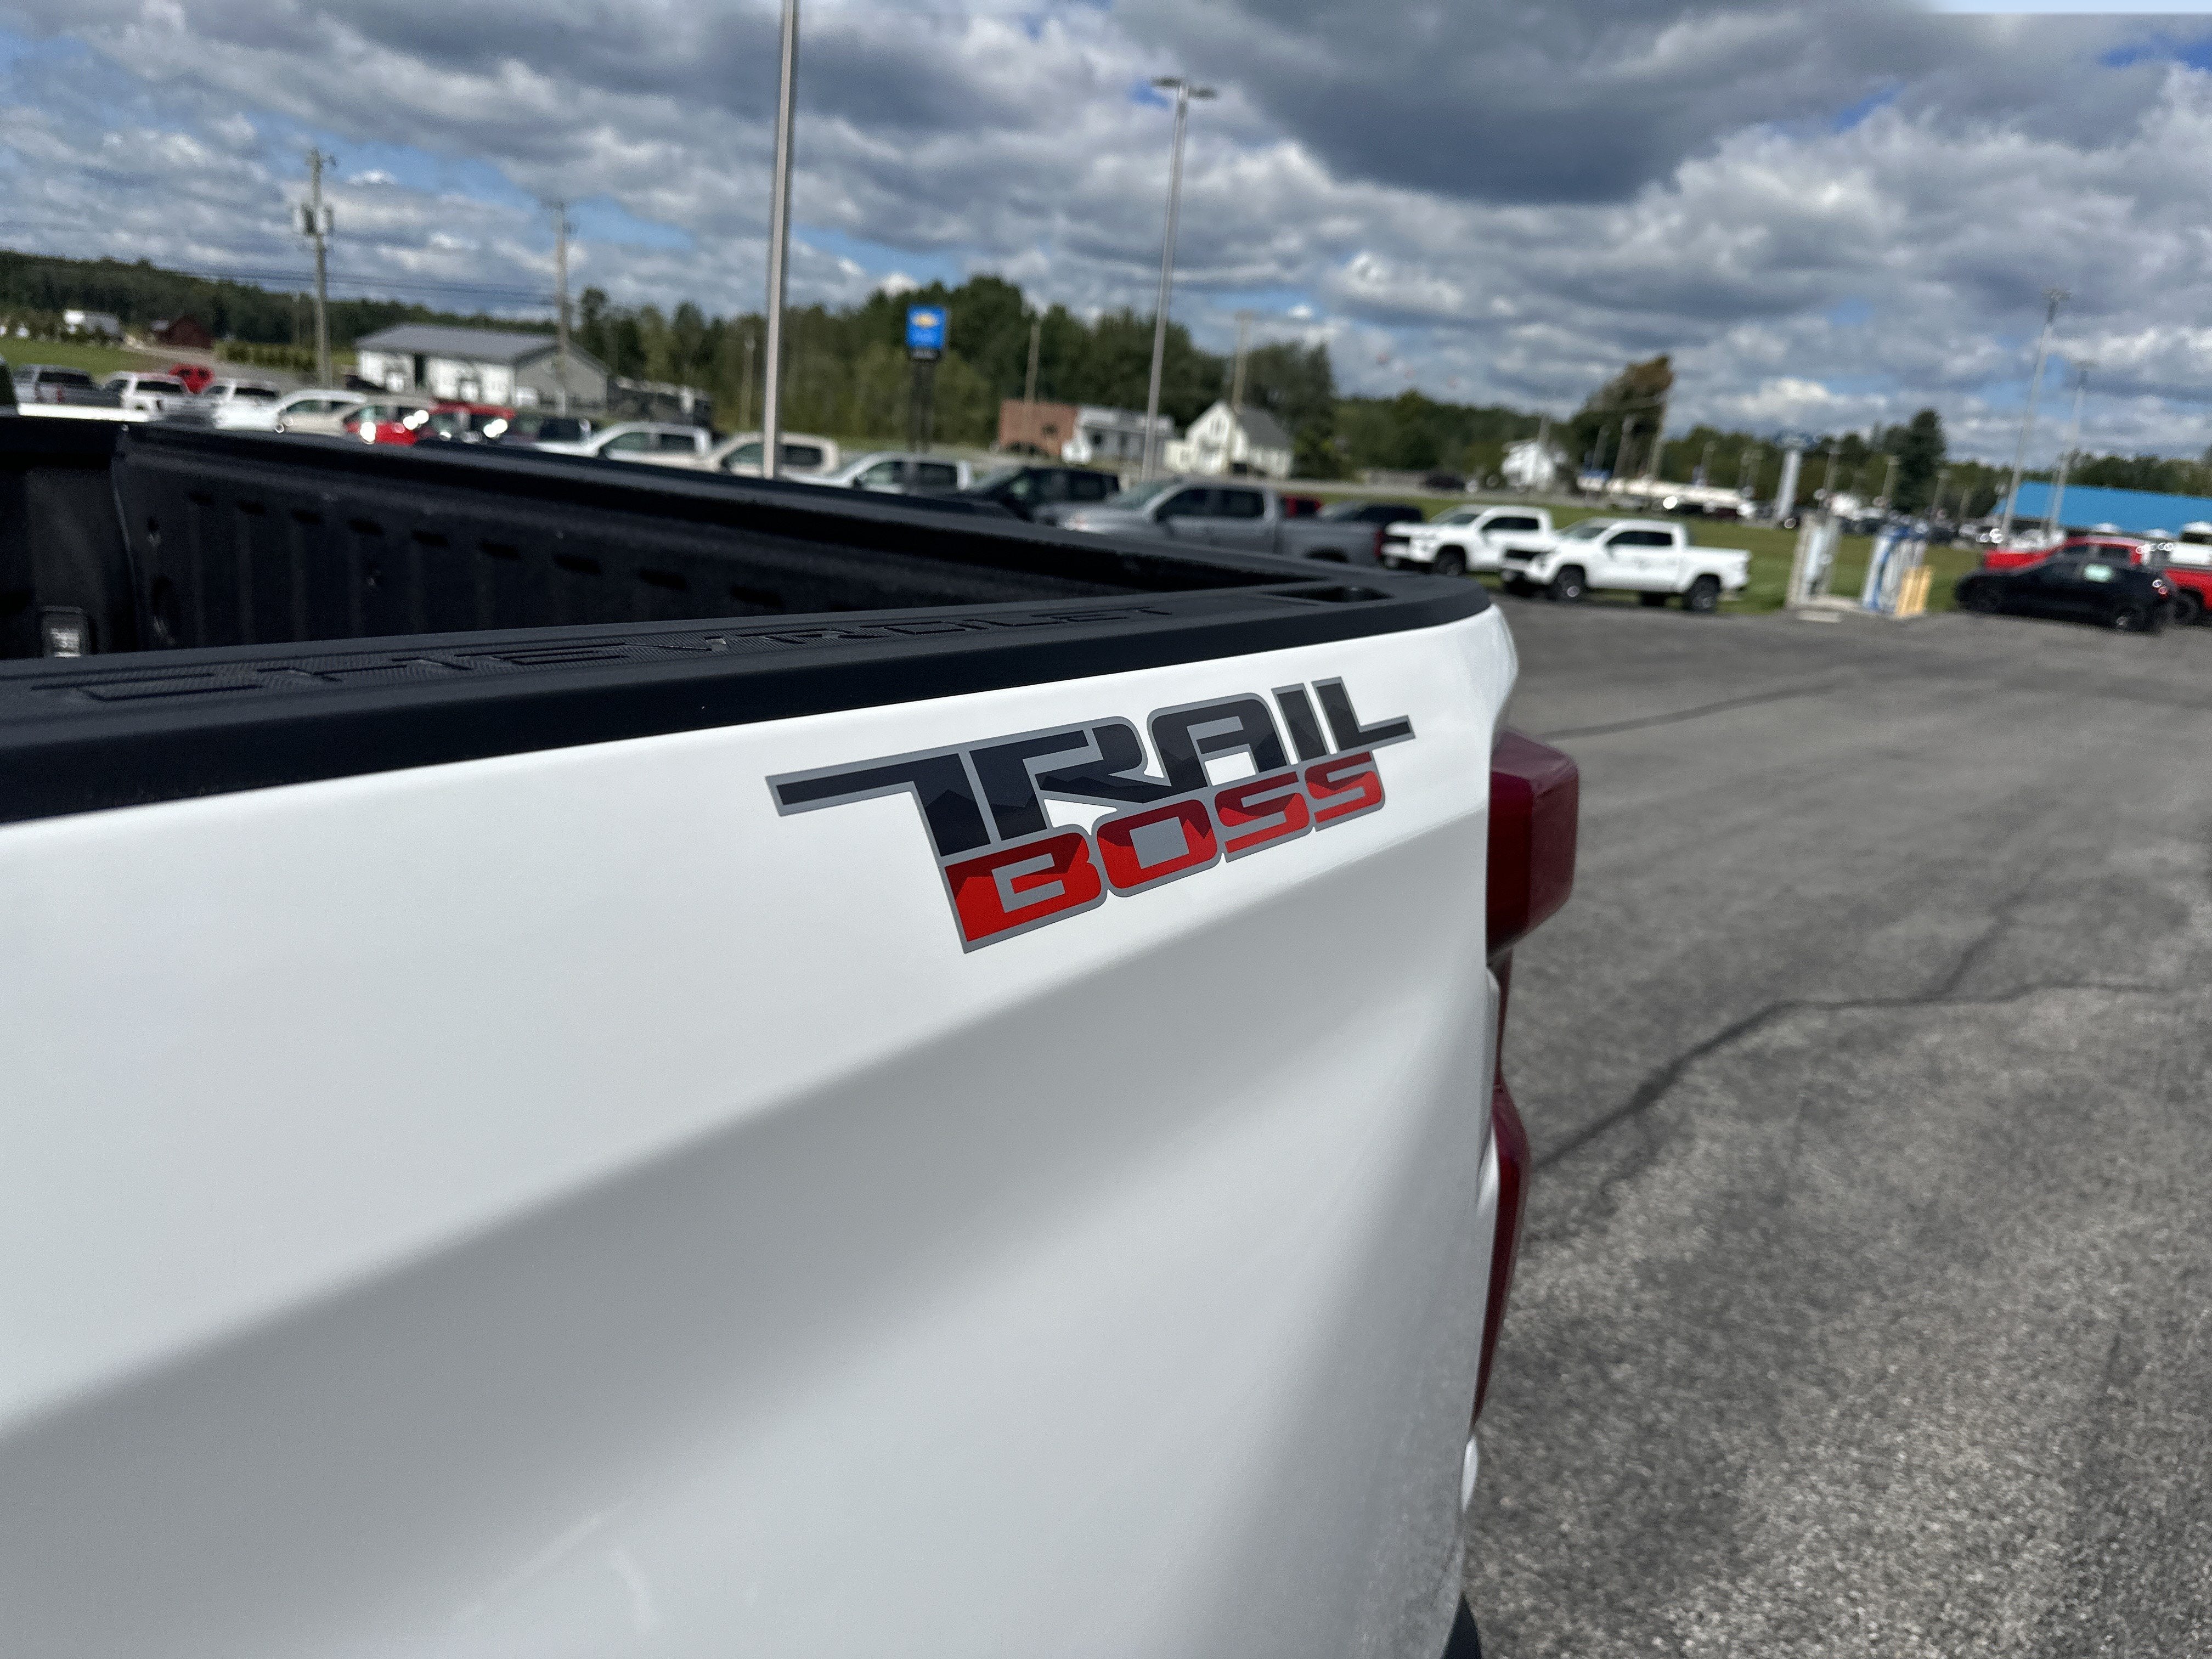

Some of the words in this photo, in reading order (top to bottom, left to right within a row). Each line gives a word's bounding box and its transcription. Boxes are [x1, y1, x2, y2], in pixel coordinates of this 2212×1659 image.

[31, 606, 1173, 702] CHEVROLET
[767, 677, 1415, 857] TRAIL
[944, 751, 1385, 951] BOSS
